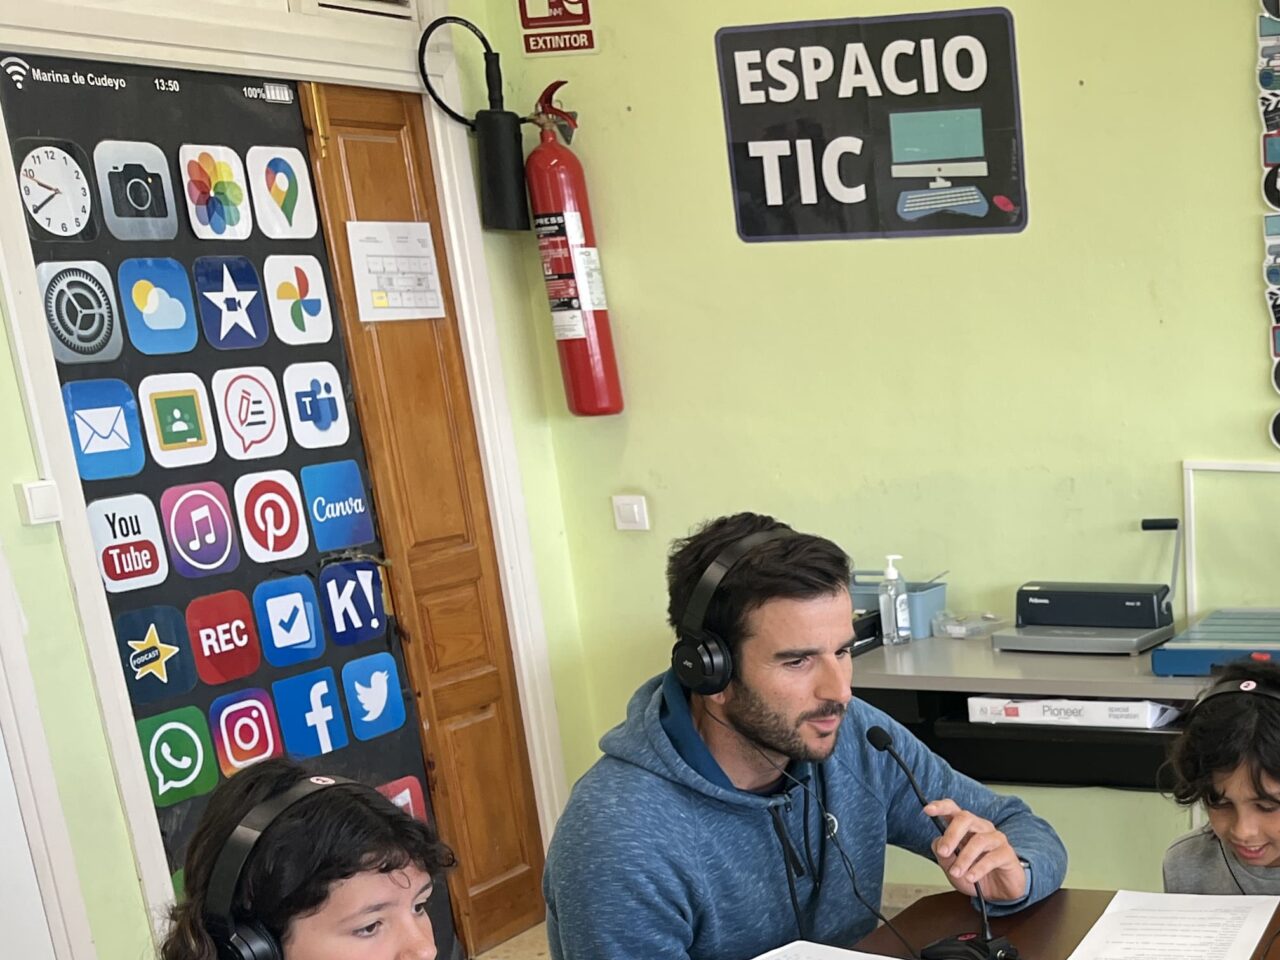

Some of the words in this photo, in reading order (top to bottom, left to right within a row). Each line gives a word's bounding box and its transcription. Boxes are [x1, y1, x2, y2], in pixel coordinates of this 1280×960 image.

[529, 33, 589, 50] EXTINTOR
[734, 35, 988, 104] ESPACIO
[31, 68, 70, 85] Marina
[72, 73, 85, 84] de
[87, 74, 126, 90] Cudeyo
[154, 79, 180, 92] 13:50
[242, 87, 266, 99] 100%
[32, 155, 41, 165] 11
[45, 150, 55, 161] 12
[62, 156, 68, 165] 1
[24, 168, 35, 179] 10
[74, 170, 81, 180] 2
[748, 136, 867, 207] TIC
[24, 186, 31, 196] 9
[81, 187, 87, 197] 3
[81, 204, 87, 214] 4
[45, 218, 51, 227] 7
[61, 222, 68, 233] 6
[75, 218, 81, 228] 5
[301, 397, 313, 416] T
[312, 496, 365, 522] Canva
[105, 512, 141, 539] You
[108, 546, 152, 575] Tube
[326, 569, 380, 634] K!
[199, 619, 249, 657] REC
[132, 649, 159, 666] PODCAST
[1042, 705, 1084, 719] Pioneer
